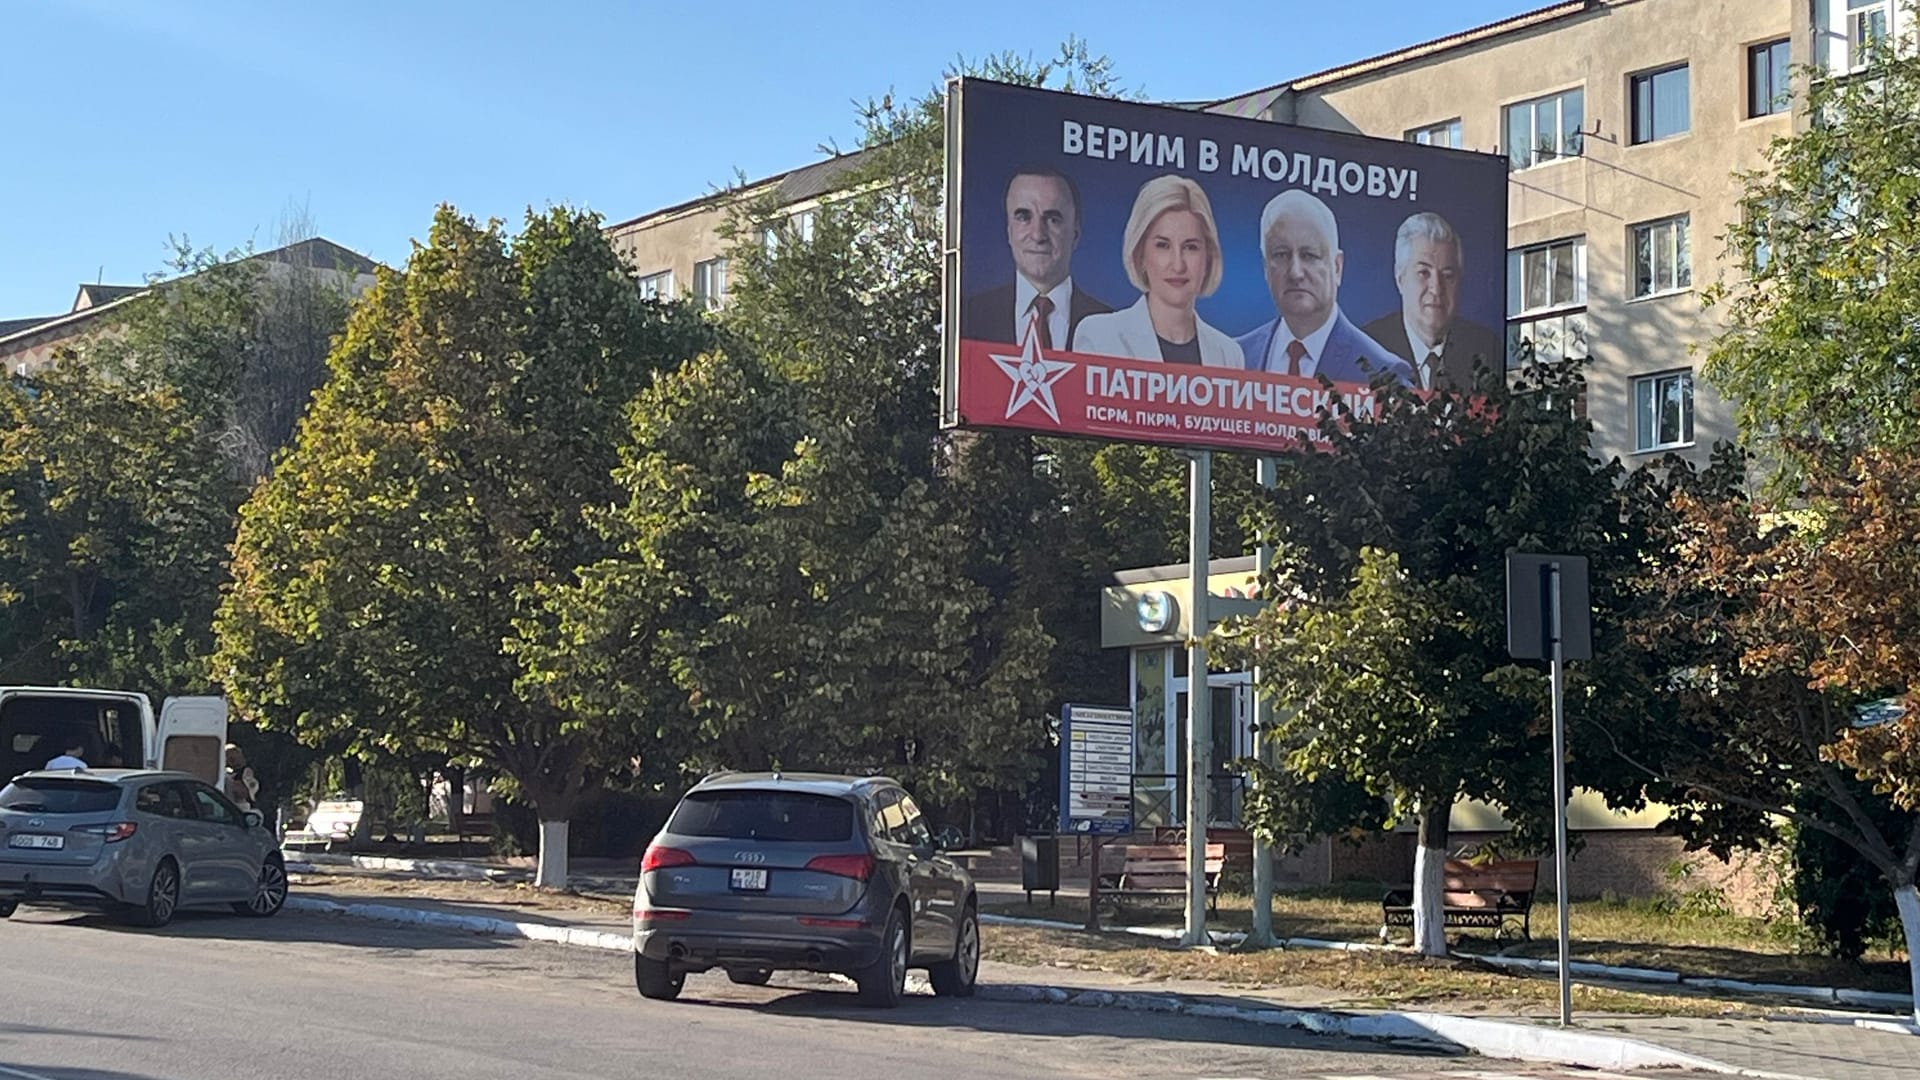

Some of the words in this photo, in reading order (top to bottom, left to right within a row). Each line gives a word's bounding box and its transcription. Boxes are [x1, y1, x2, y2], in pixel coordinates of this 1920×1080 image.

[1063, 120, 1185, 169] ВЕРИМ
[1197, 140, 1220, 173] В
[1232, 144, 1419, 201] МОЛДОВУ!
[1086, 365, 1375, 424] ПАТРИОТИЧЕСКИЙ
[1135, 410, 1181, 431] ПКРМ,
[1184, 415, 1251, 435] БУДУЩЕЕ
